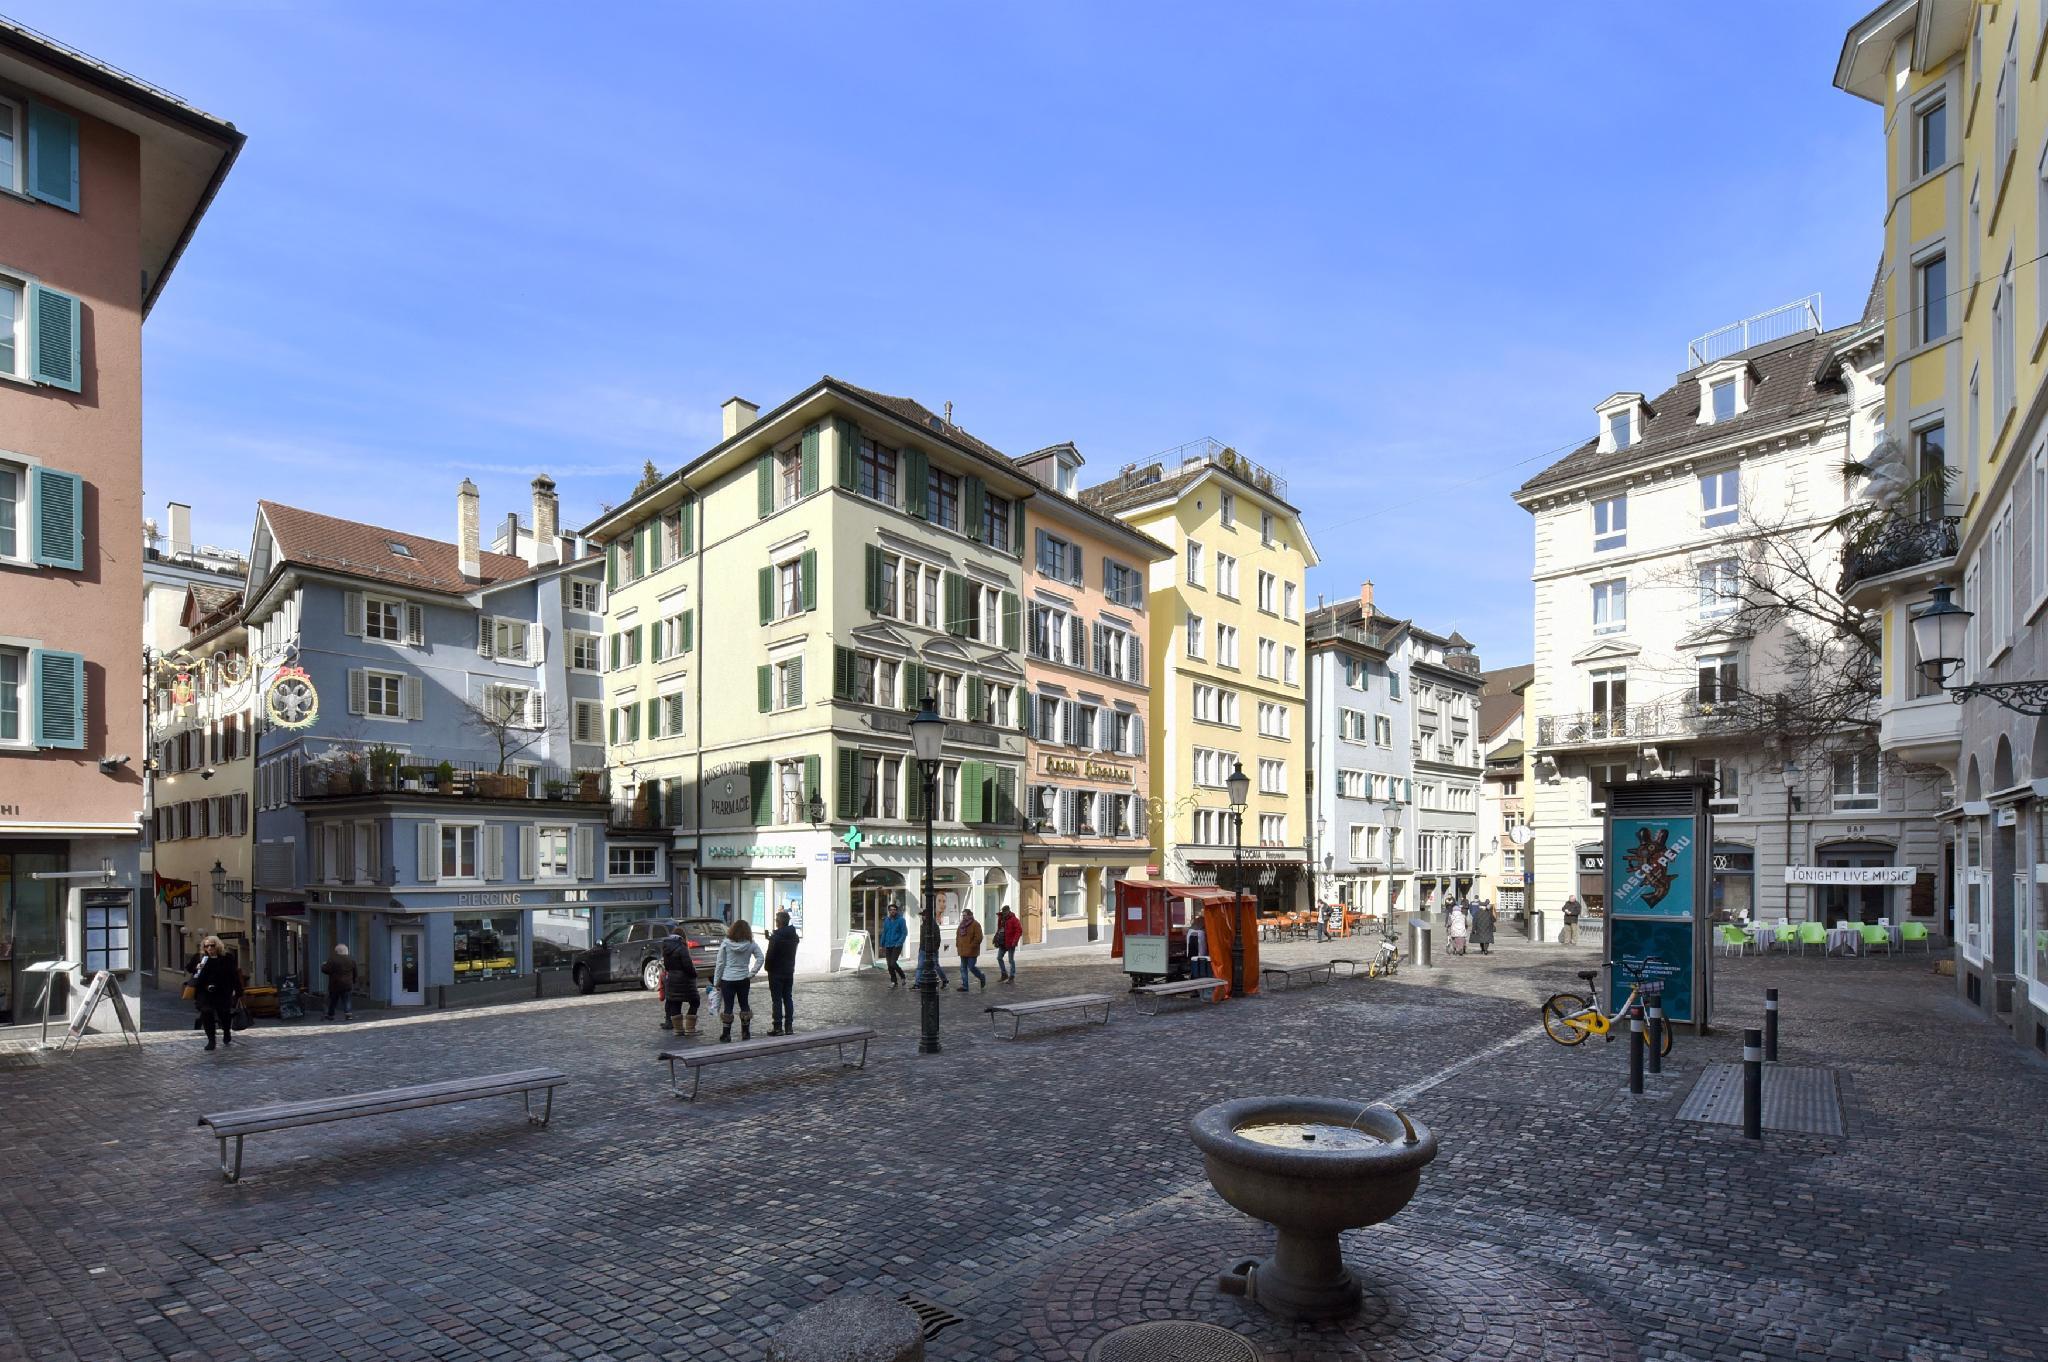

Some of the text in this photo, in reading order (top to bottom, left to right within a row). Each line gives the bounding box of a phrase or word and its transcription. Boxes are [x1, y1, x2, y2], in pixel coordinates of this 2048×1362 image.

[704, 760, 751, 787] ROSENAPOTHE
[1846, 825, 1865, 833] BAR
[1657, 835, 1691, 867] PERU
[1792, 870, 1909, 881] TONIGHT LIVE MUSIC
[173, 896, 189, 908] BAR
[458, 893, 521, 906] PIERCING
[564, 890, 588, 902] INK
